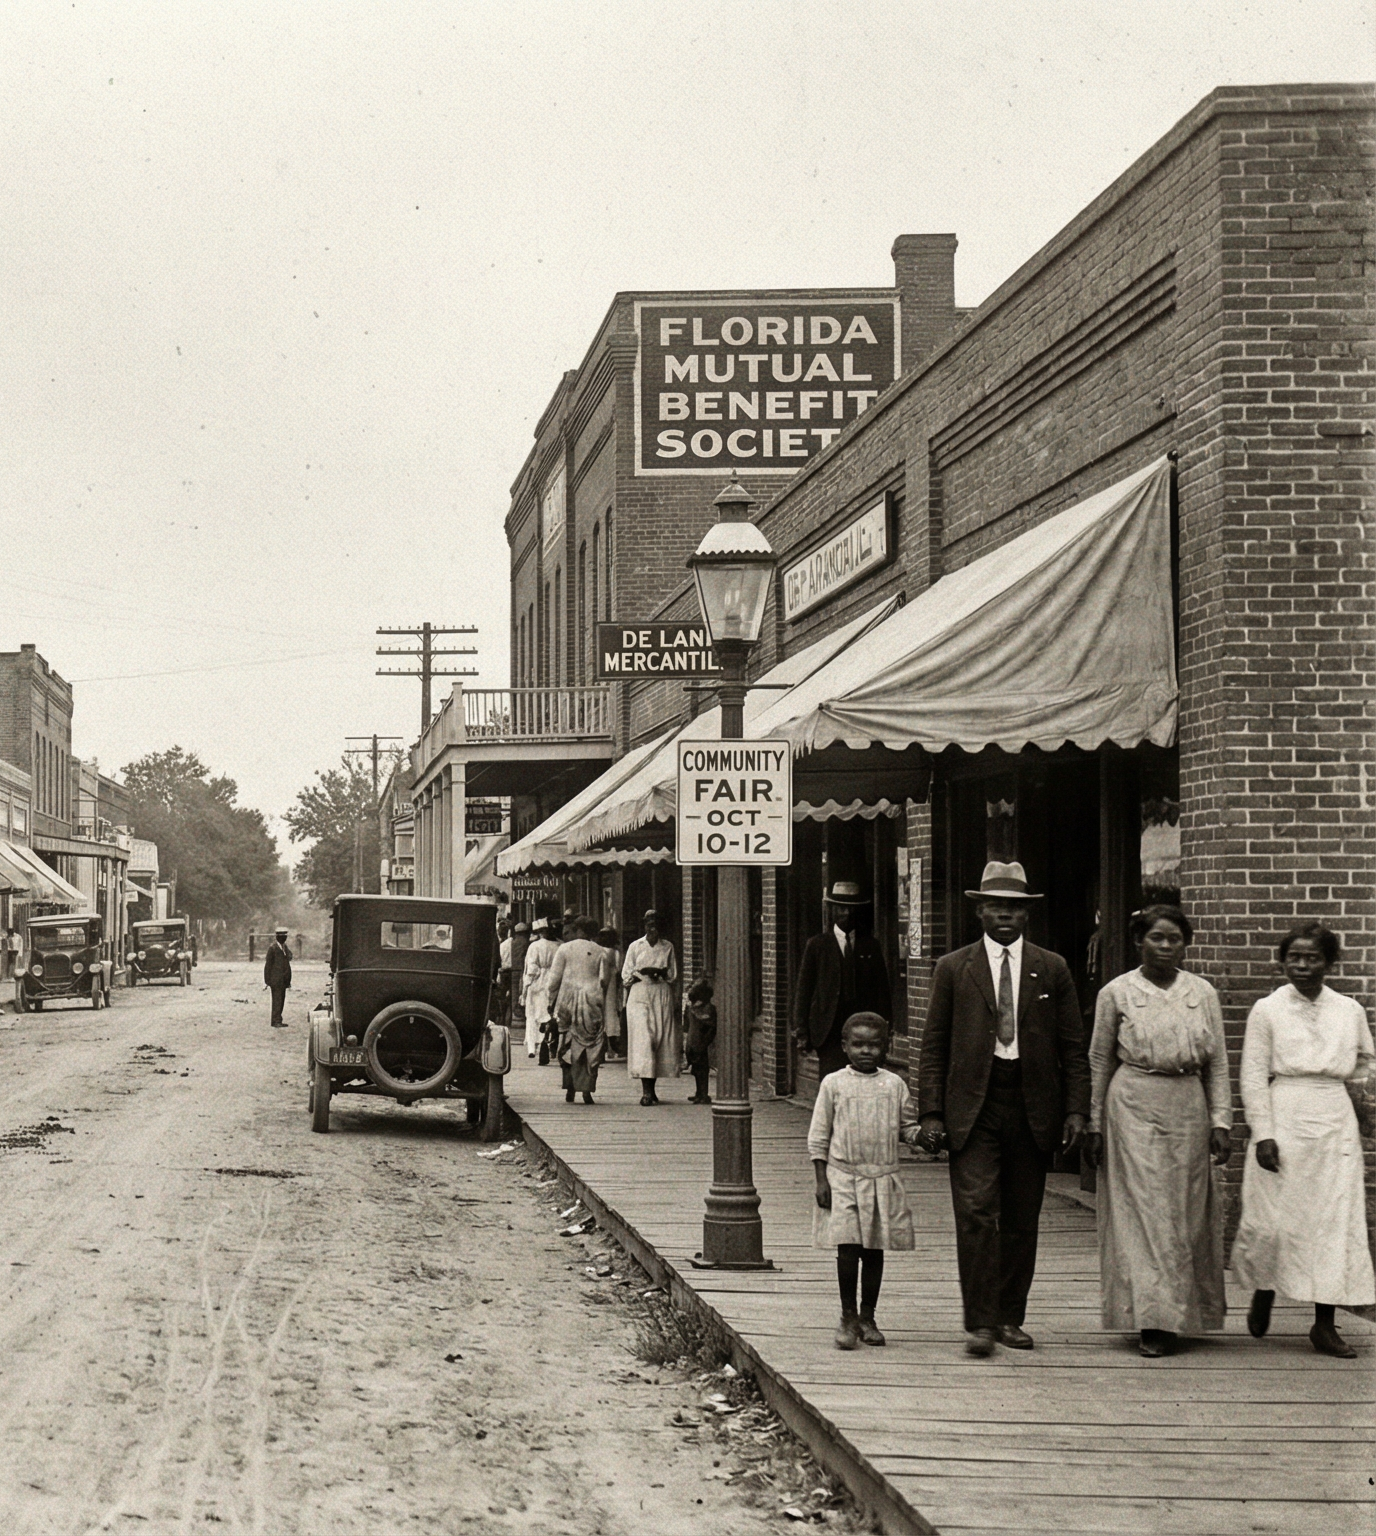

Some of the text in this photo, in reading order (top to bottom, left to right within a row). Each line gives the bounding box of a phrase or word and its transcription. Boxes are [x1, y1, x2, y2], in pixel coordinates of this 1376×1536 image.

[659, 315, 879, 346] FLORIDA
[664, 352, 873, 384] MUTUAL
[658, 390, 878, 421] BENEFIT
[655, 428, 841, 458] SOCIET
[622, 630, 652, 648] DE
[604, 650, 724, 672] MERCANTIL
[683, 750, 785, 772] COMMUNITY
[697, 832, 771, 854] 10-12
